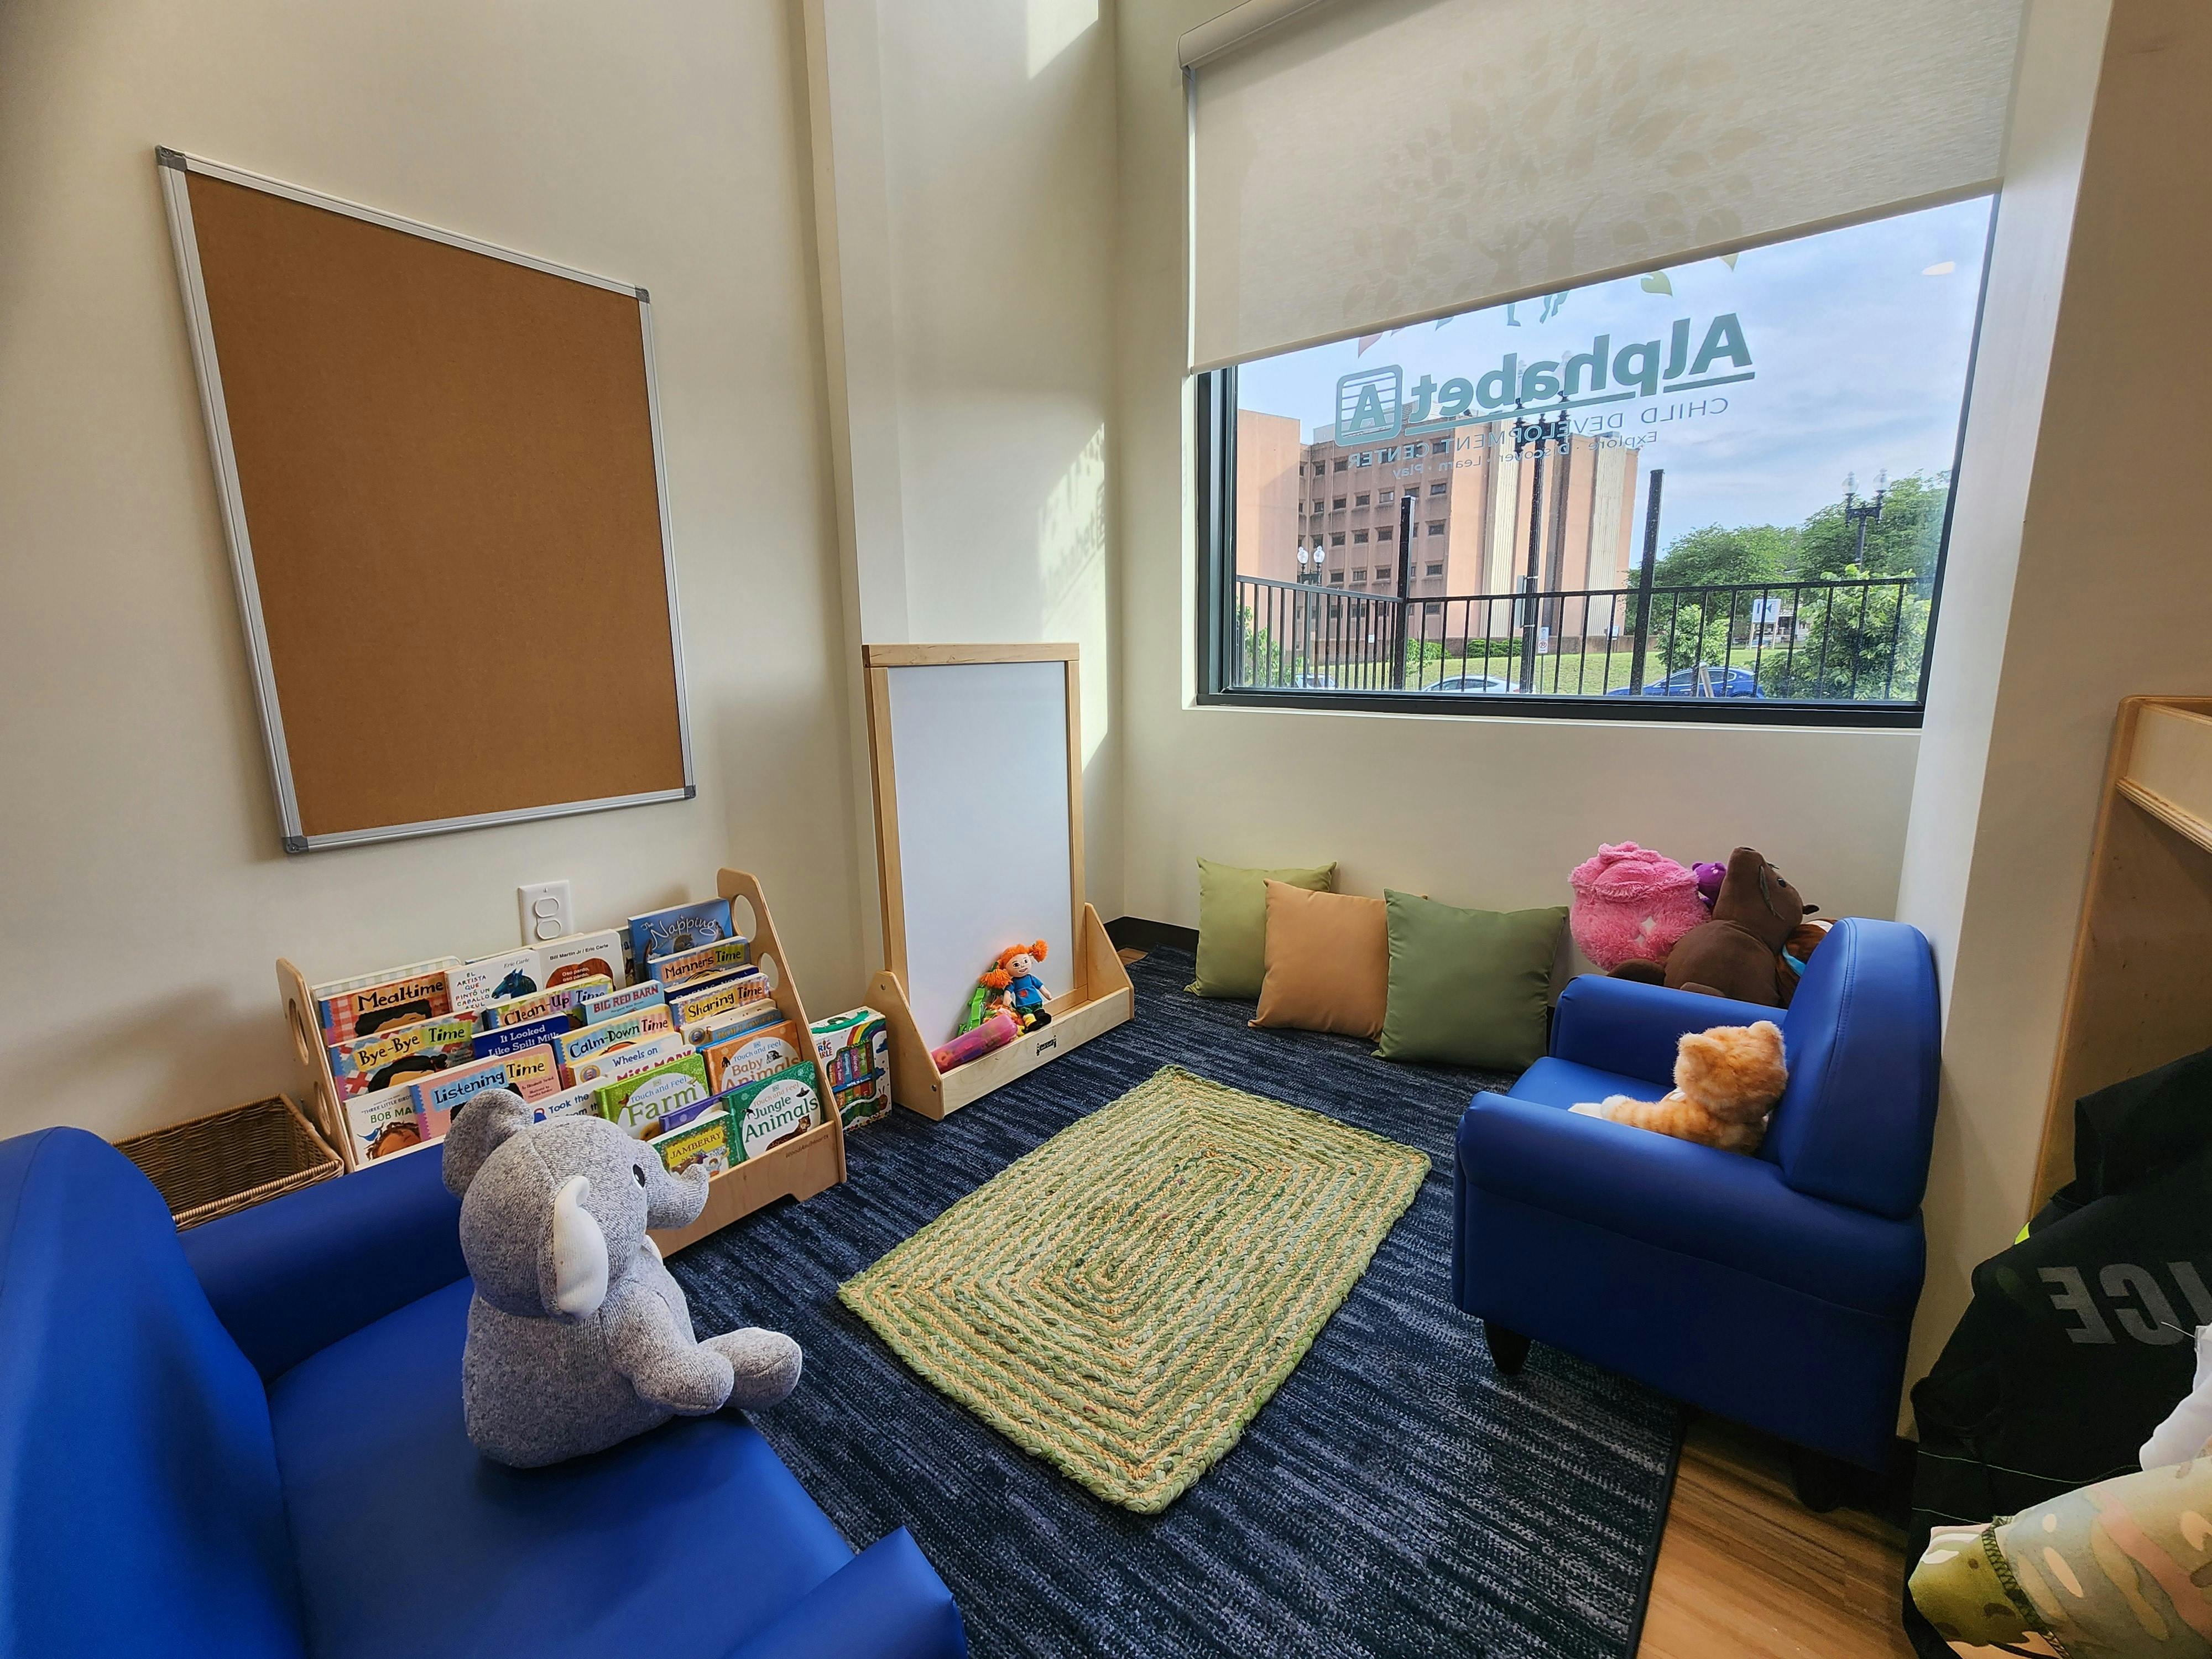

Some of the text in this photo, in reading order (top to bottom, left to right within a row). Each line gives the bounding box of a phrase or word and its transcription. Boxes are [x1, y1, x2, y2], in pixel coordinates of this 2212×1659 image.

[640, 922, 655, 931] The
[650, 915, 717, 951] Napping
[559, 951, 576, 959] Martin
[665, 950, 741, 979] Manners Time
[457, 975, 487, 987] ARTISTA
[357, 981, 444, 1012] Mealtime
[457, 994, 490, 1007] CABALLO
[504, 990, 605, 1026] Clean-Up Time
[593, 985, 659, 1014] BIG RED BARN
[687, 992, 734, 1018] Sharing
[737, 985, 763, 999] Time
[357, 1027, 466, 1066] Bye-Bye Time
[488, 1047, 510, 1057] Like
[512, 1038, 535, 1051] Spilt
[538, 1032, 560, 1044] Milk
[500, 1024, 546, 1044] It Looked
[570, 1019, 668, 1058] Calm-Down Time
[817, 1042, 831, 1053] RIC
[612, 1047, 658, 1067] Wheels on
[733, 1051, 753, 1062] Touch
[754, 1046, 766, 1055] and
[767, 1039, 781, 1050] Feel
[726, 1056, 800, 1089] Animals
[732, 1058, 763, 1076] Baby
[433, 1071, 505, 1104] Listening
[506, 1062, 546, 1079] Time
[630, 1090, 654, 1103] Touch
[655, 1083, 669, 1094] and
[671, 1076, 687, 1088] Feel
[753, 1096, 773, 1107] Touch
[773, 1090, 785, 1099] and
[785, 1082, 800, 1093] Feel
[370, 1107, 414, 1124] BOB MA
[548, 1099, 572, 1114] Took
[574, 1093, 589, 1104] the
[627, 1087, 698, 1128] Farm
[754, 1096, 791, 1120] Jungle
[745, 1097, 818, 1143] Animals
[670, 1131, 721, 1159] JAMBERRY
[2037, 1260, 2212, 1345] ICE
